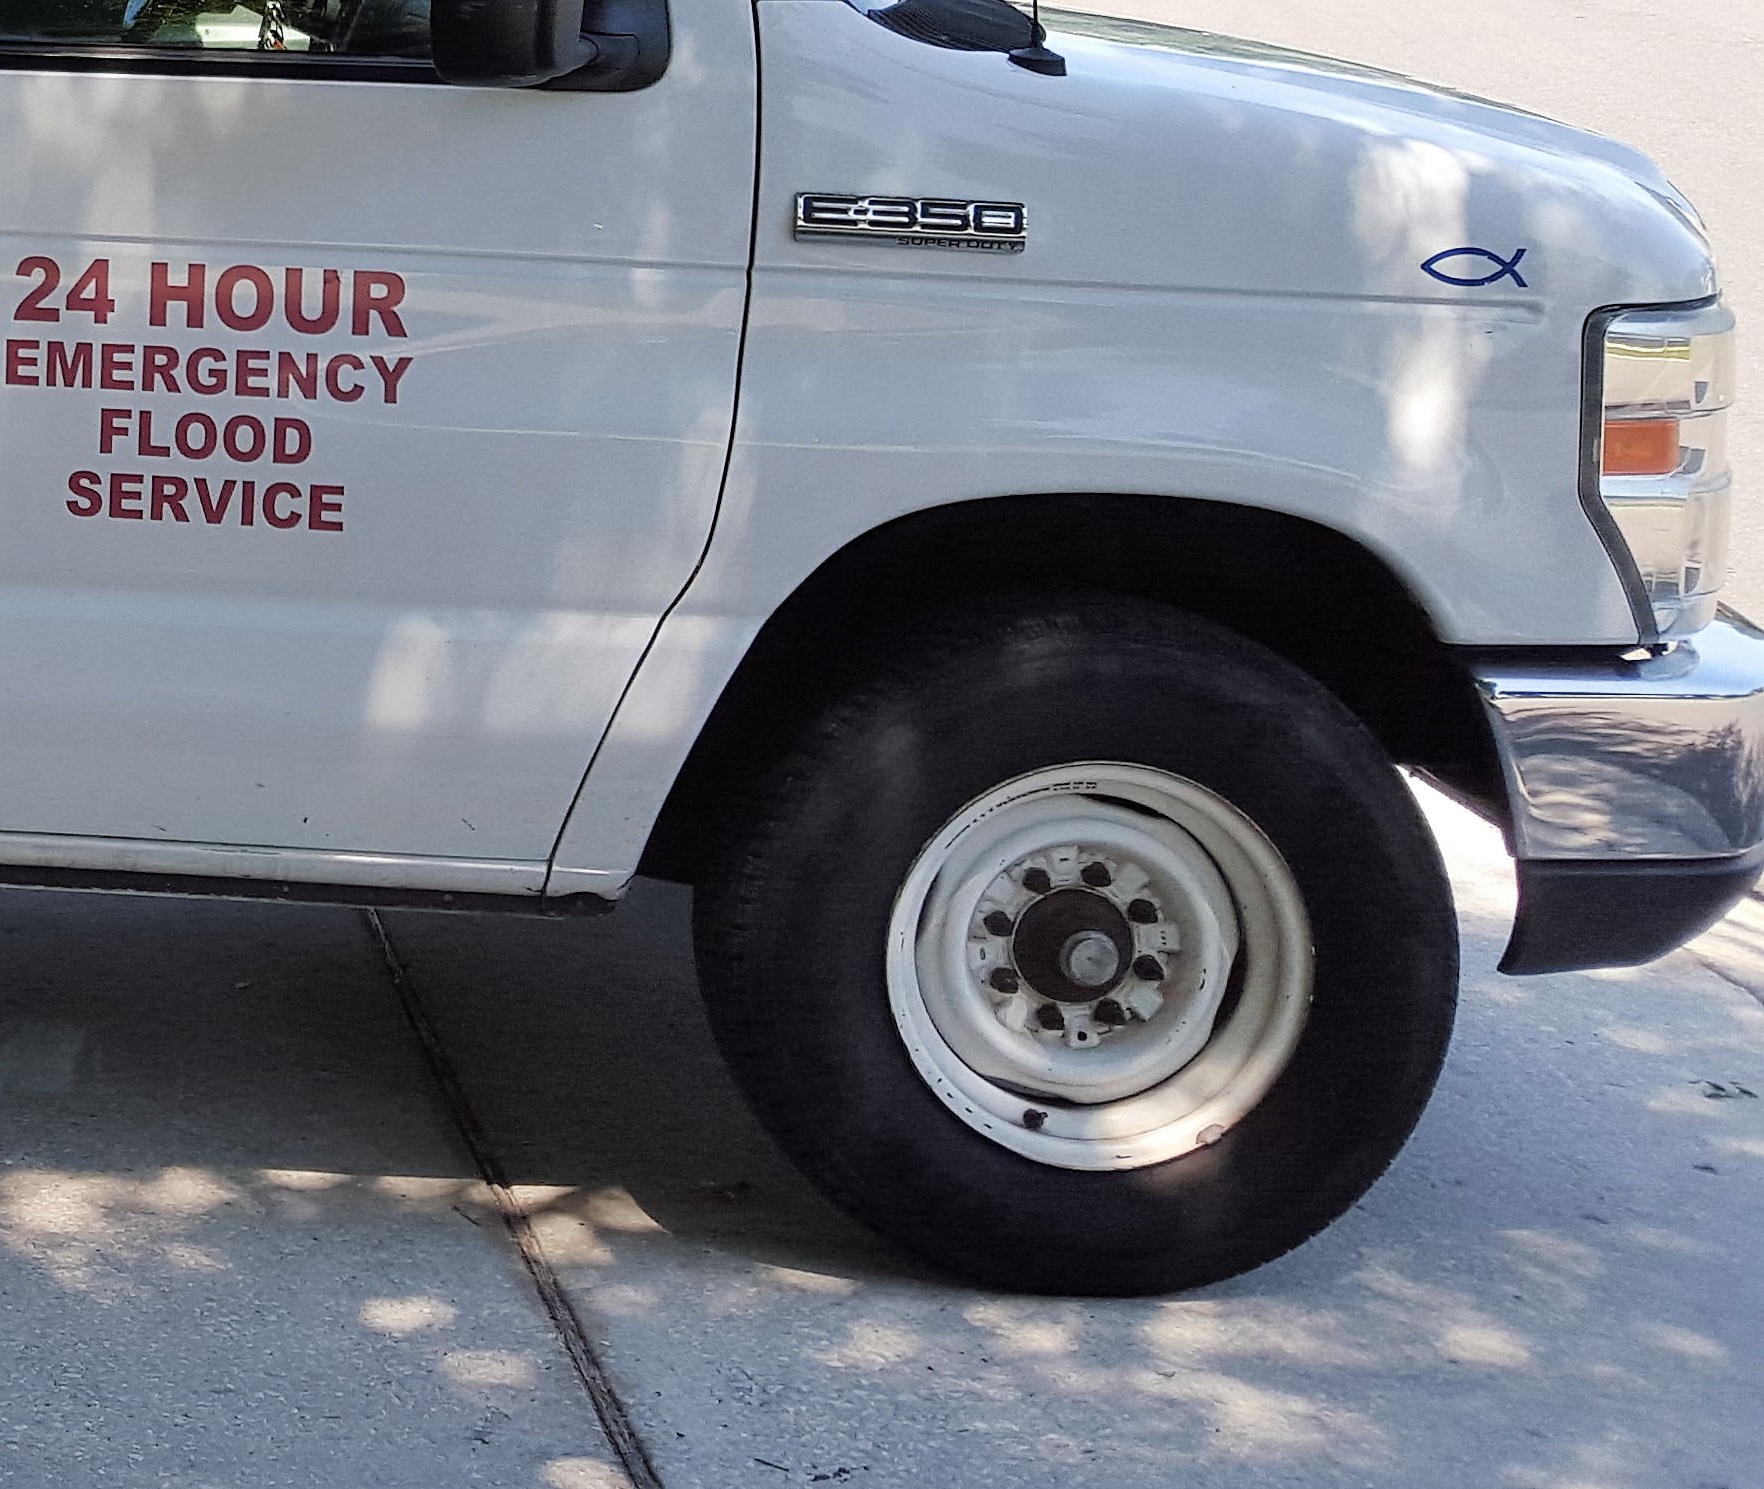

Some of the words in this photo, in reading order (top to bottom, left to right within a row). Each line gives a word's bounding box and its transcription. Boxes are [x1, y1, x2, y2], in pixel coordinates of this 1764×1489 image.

[797, 194, 1027, 237] E-350
[897, 236, 960, 248] SUPER
[967, 239, 1020, 250] DUTY
[13, 255, 115, 325] 24
[149, 261, 408, 338] HOUR
[5, 338, 414, 404] EMERGENCY
[99, 408, 312, 464] FLOOD
[66, 470, 345, 532] SERVICE
